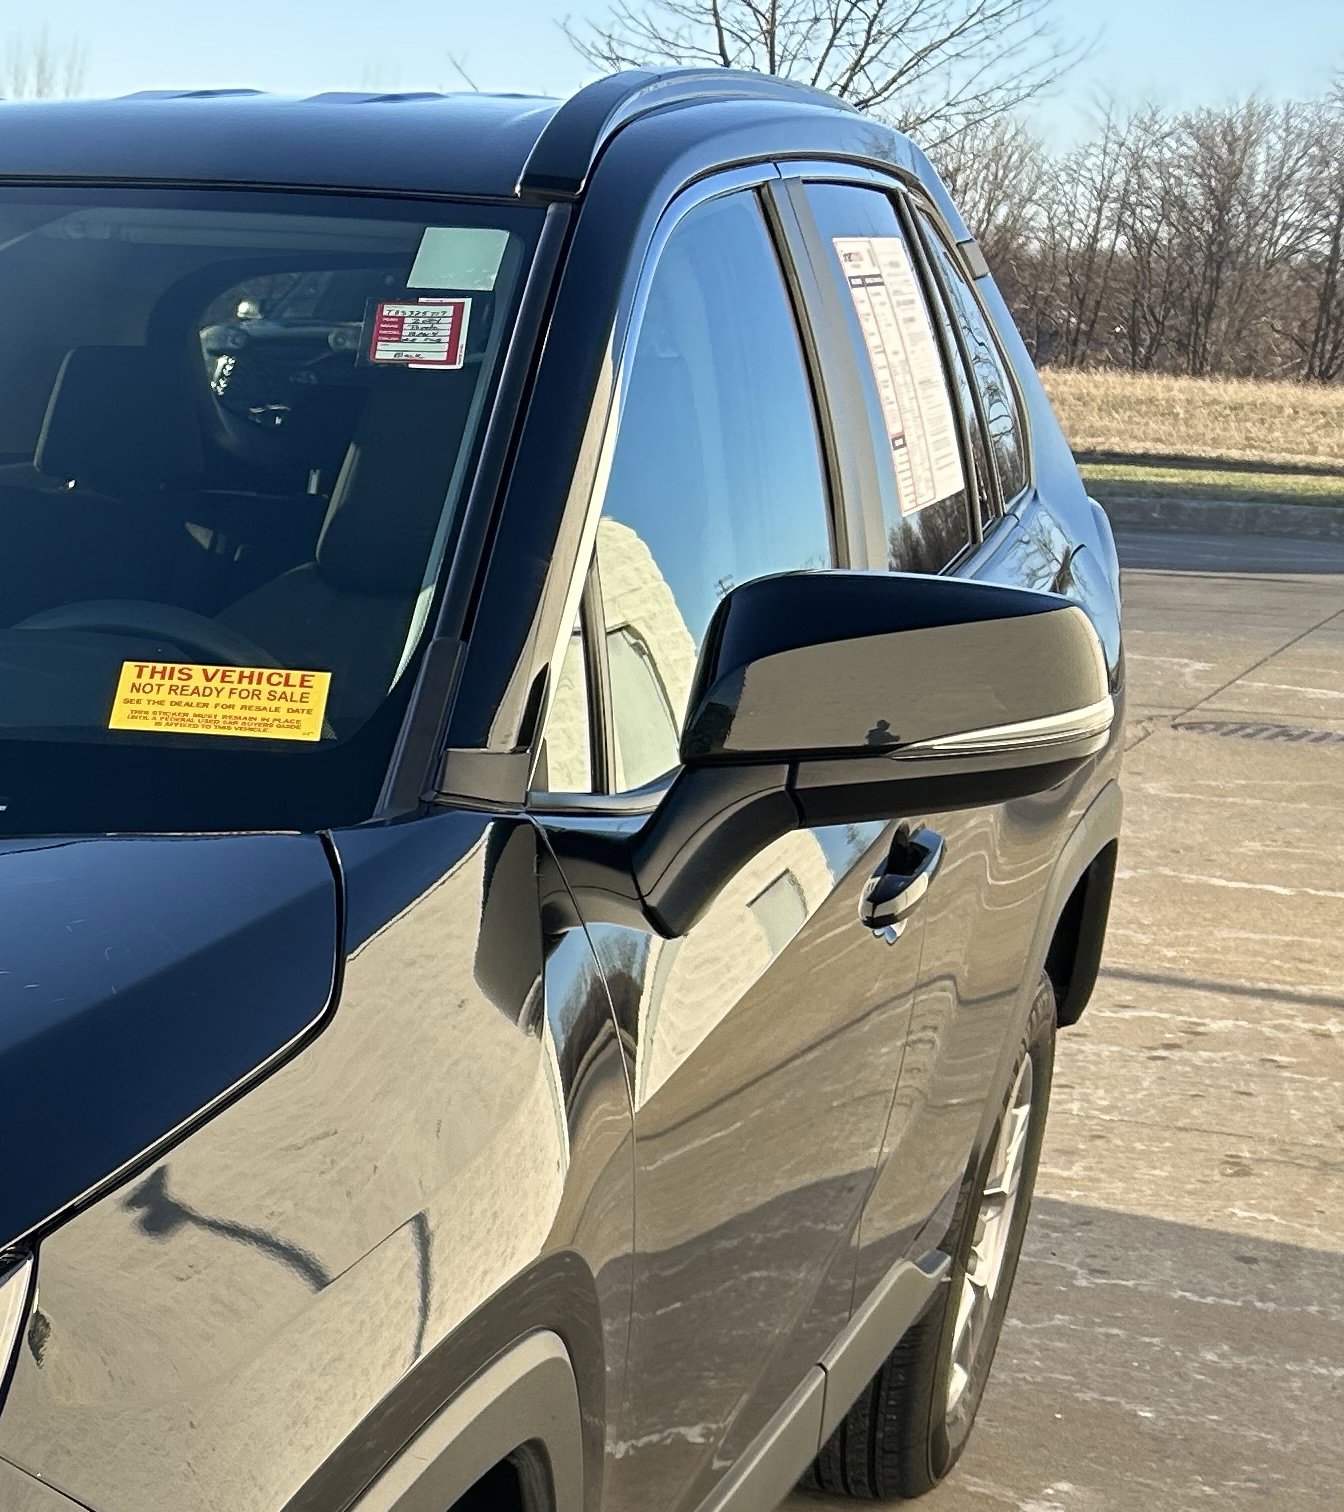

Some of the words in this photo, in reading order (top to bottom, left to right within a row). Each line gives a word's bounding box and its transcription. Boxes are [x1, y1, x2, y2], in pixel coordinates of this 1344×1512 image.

[134, 664, 193, 681] THIS
[202, 668, 315, 689] VEHICLE
[130, 682, 164, 694] NOT
[168, 684, 225, 698] READY
[228, 687, 262, 701] FOR
[267, 690, 310, 703] SALE
[123, 697, 143, 705] SEE
[146, 698, 166, 706] THE
[169, 700, 209, 708] DEALER
[214, 702, 236, 710] FOR
[240, 704, 281, 713] RESALE
[286, 707, 313, 715] DATE
